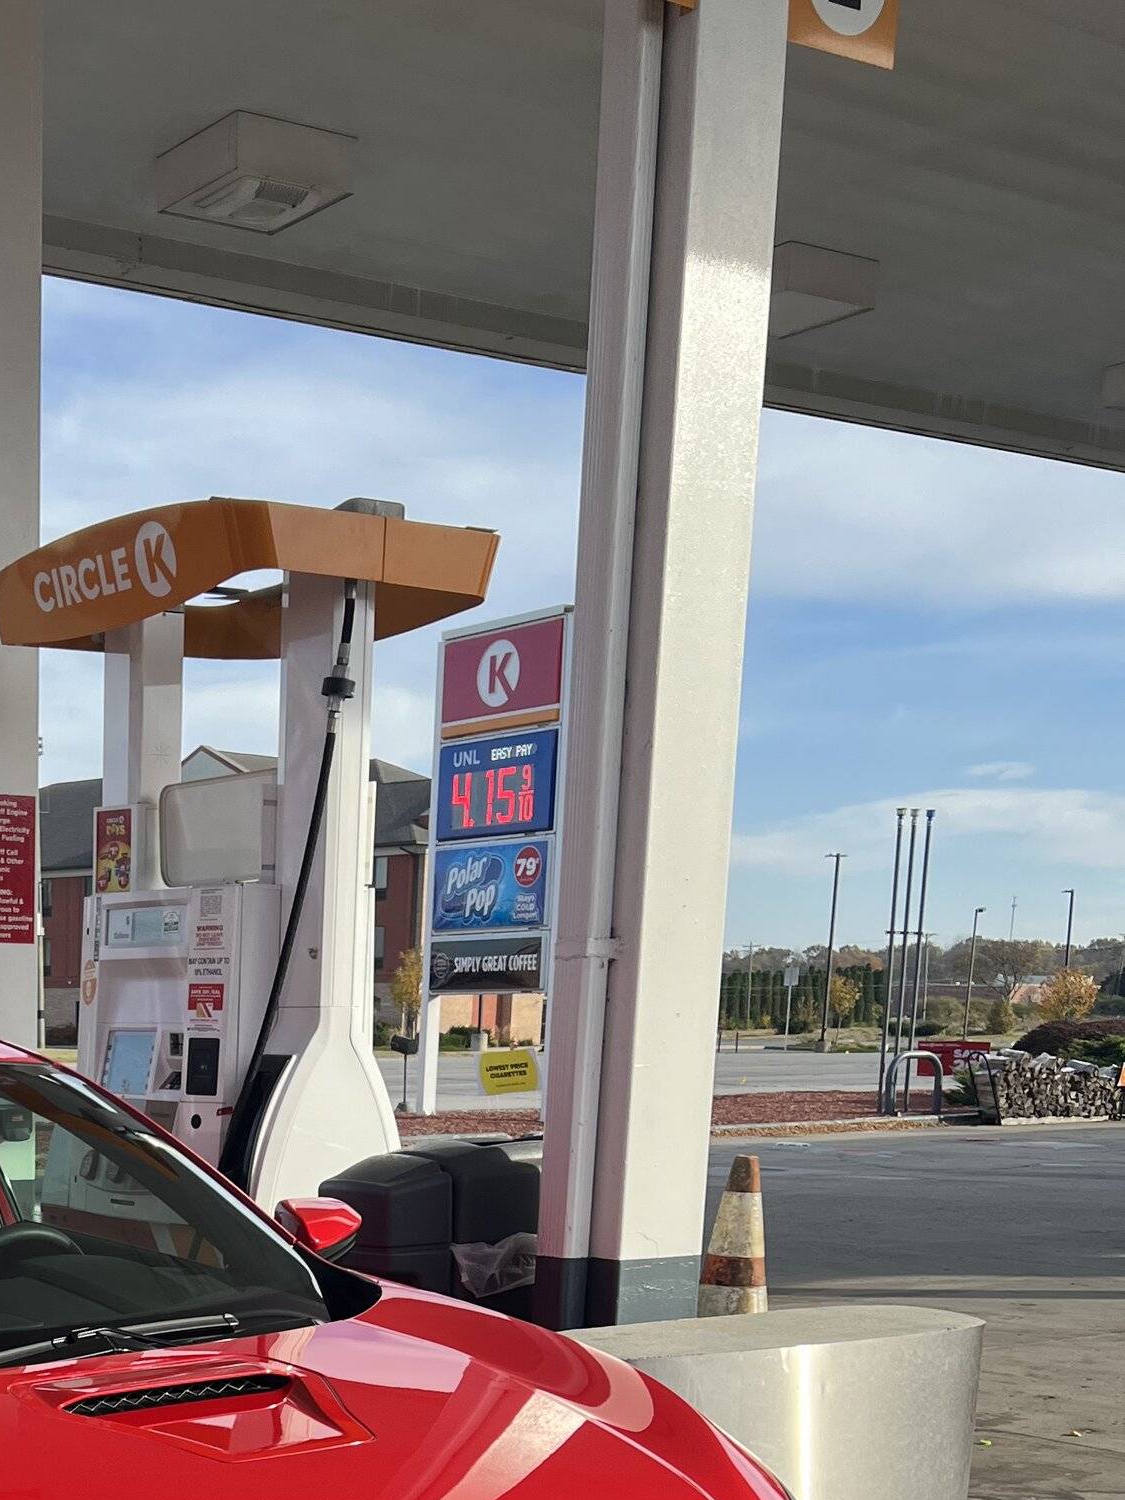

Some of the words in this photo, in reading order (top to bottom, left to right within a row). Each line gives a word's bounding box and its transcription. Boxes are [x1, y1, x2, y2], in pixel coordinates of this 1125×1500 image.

[33, 547, 132, 612] CIRCLE
[139, 527, 176, 593] K
[483, 646, 518, 704] K
[453, 749, 481, 768] UNL
[491, 746, 512, 761] EASY
[515, 743, 534, 757] PAY
[6, 808, 28, 817] Engine
[1, 834, 25, 843] Fueling
[445, 856, 488, 896] Polar
[464, 884, 496, 919] Pop
[7, 915, 33, 923] gasoline
[453, 956, 482, 974] SIMPLY
[482, 954, 508, 972] GREAT
[508, 953, 538, 971] COFFEE
[486, 1063, 510, 1073] LOWEST
[510, 1062, 528, 1071] PRICE
[490, 1070, 527, 1079] CIGARETTES
